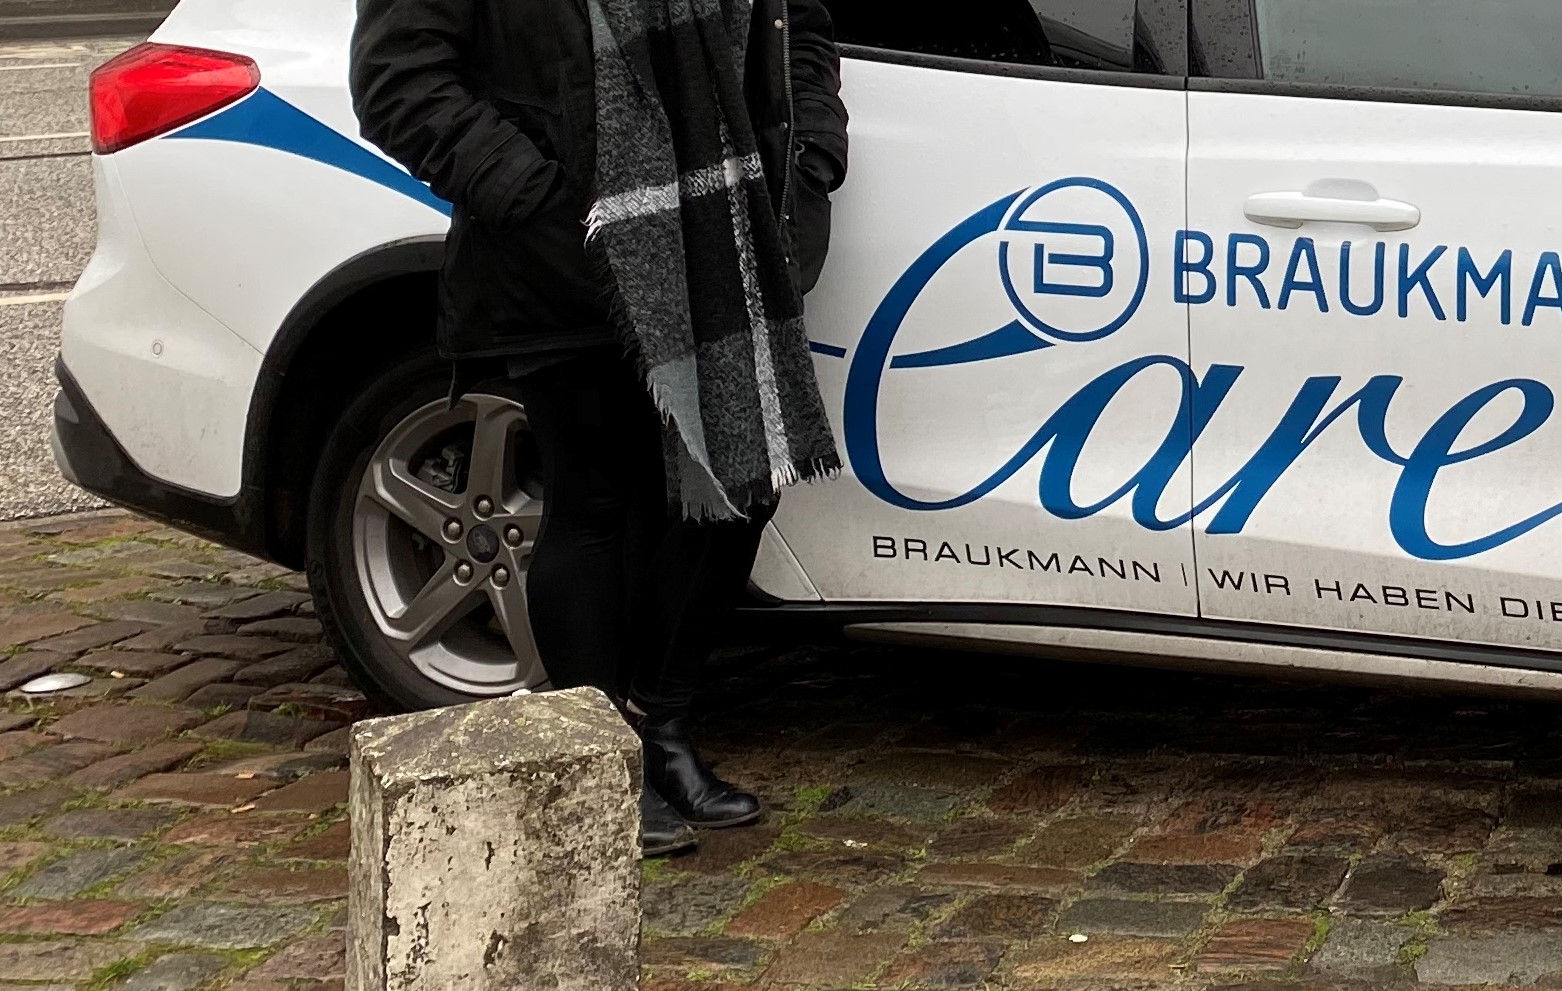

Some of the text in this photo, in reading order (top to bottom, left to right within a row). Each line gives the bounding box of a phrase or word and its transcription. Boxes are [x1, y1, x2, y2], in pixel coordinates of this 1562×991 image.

[872, 535, 1161, 583] BRAUKMANN
[1208, 567, 1291, 596] WIR
[1314, 578, 1476, 614] HABEN
